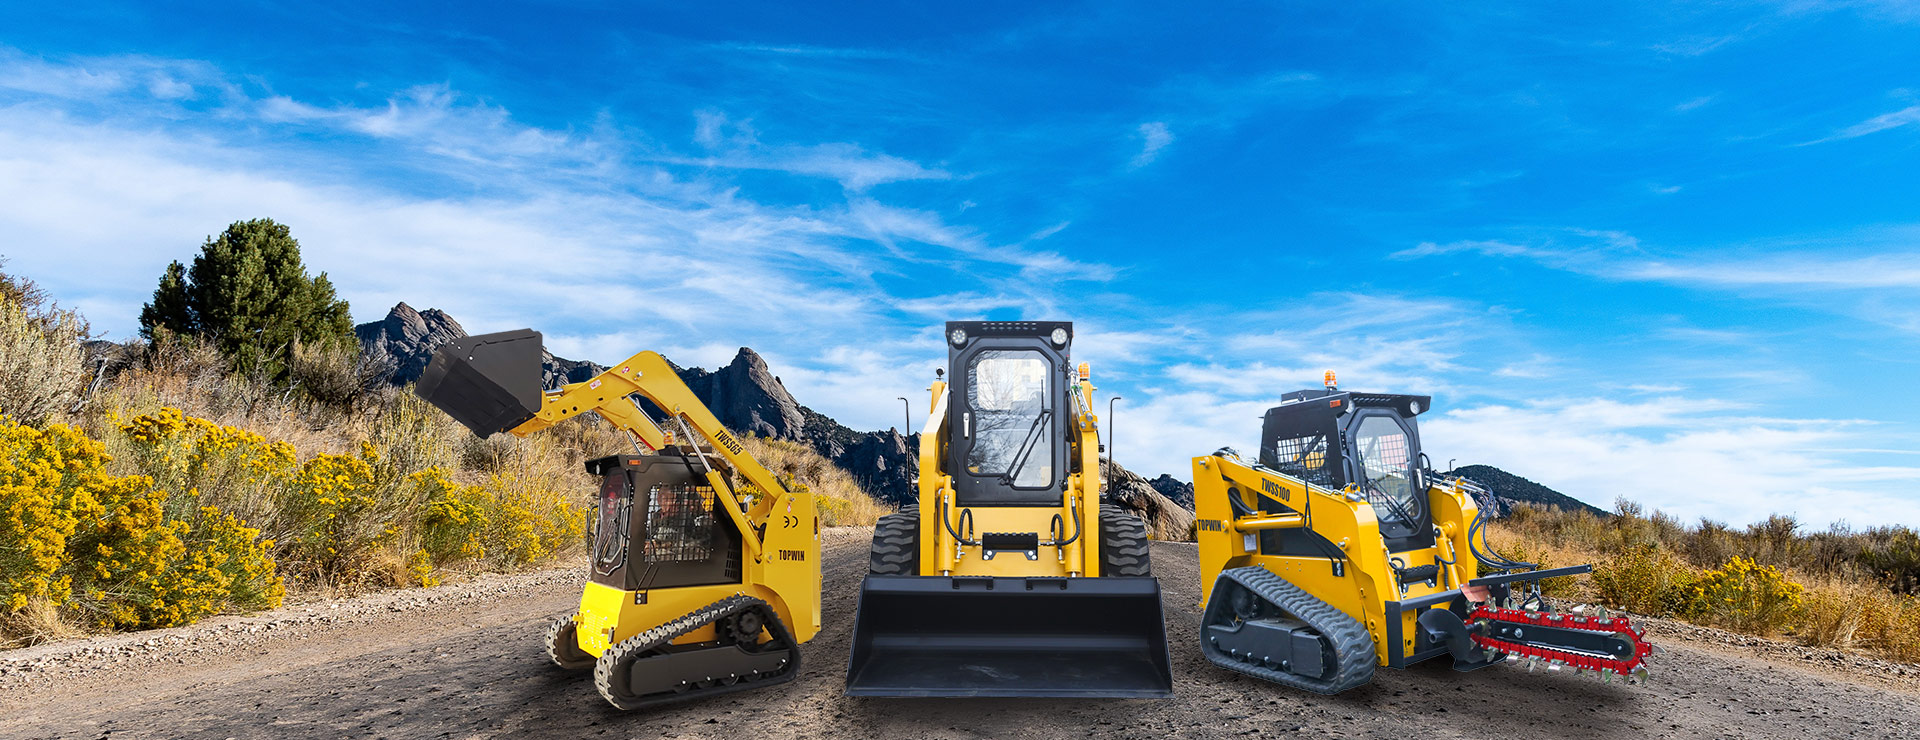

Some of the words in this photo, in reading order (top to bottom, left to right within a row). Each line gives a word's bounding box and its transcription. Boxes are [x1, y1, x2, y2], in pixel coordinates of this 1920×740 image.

[714, 429, 743, 455] TWSS65
[1261, 477, 1291, 502] TWSS100
[1197, 519, 1222, 532] TOPWIN
[779, 549, 805, 561] TOPWIN
